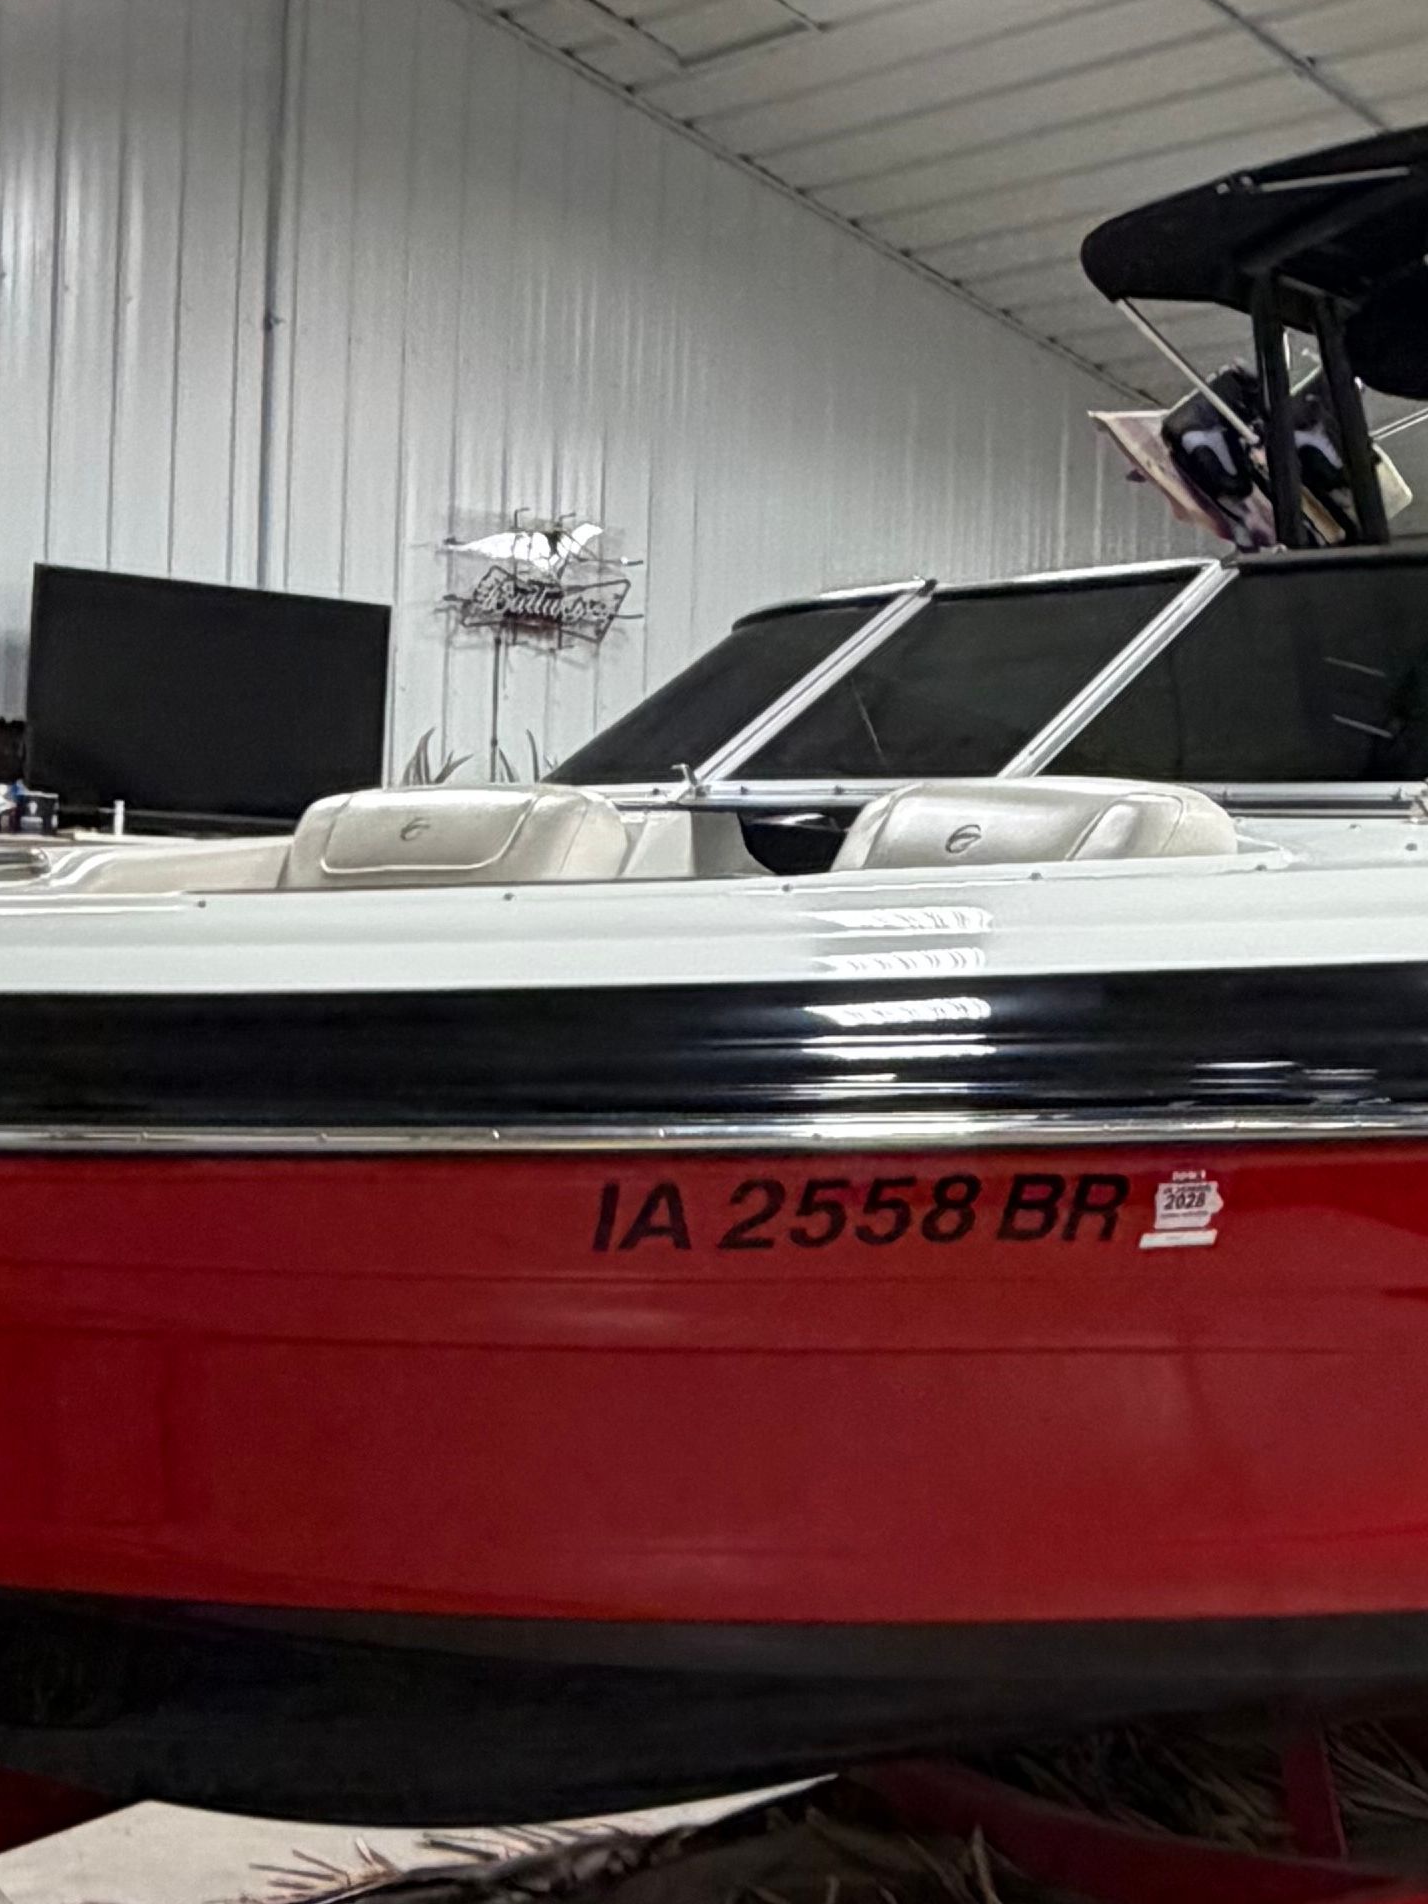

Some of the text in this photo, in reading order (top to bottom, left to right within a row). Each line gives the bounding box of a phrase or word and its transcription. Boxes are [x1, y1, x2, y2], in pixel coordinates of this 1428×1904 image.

[591, 1171, 1132, 1253] IA 2558 BR
